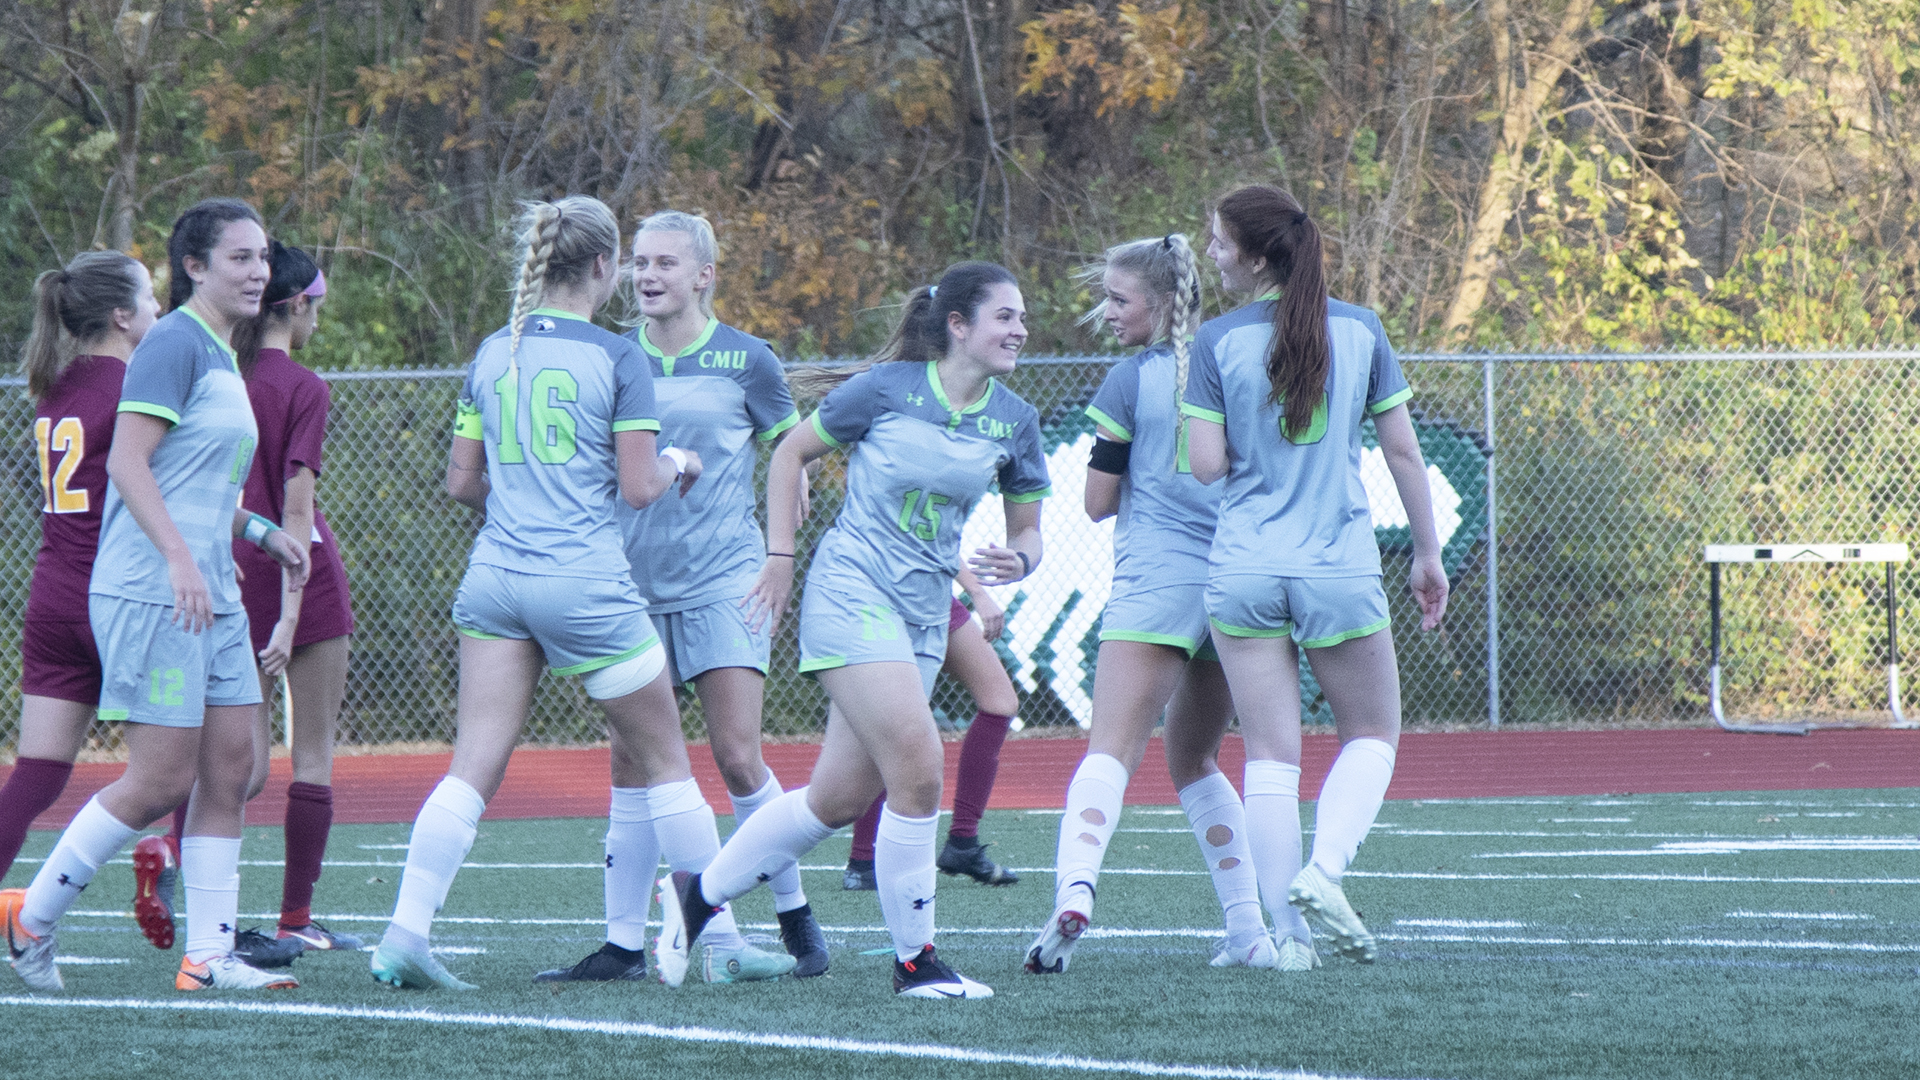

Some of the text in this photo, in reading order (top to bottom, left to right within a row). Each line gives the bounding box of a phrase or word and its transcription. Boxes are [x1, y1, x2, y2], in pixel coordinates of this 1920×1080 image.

[698, 350, 748, 370] CMU
[494, 366, 579, 465] 16
[34, 417, 90, 514] 12
[898, 487, 953, 542] 15
[861, 605, 899, 641] 15
[148, 667, 185, 706] 12
